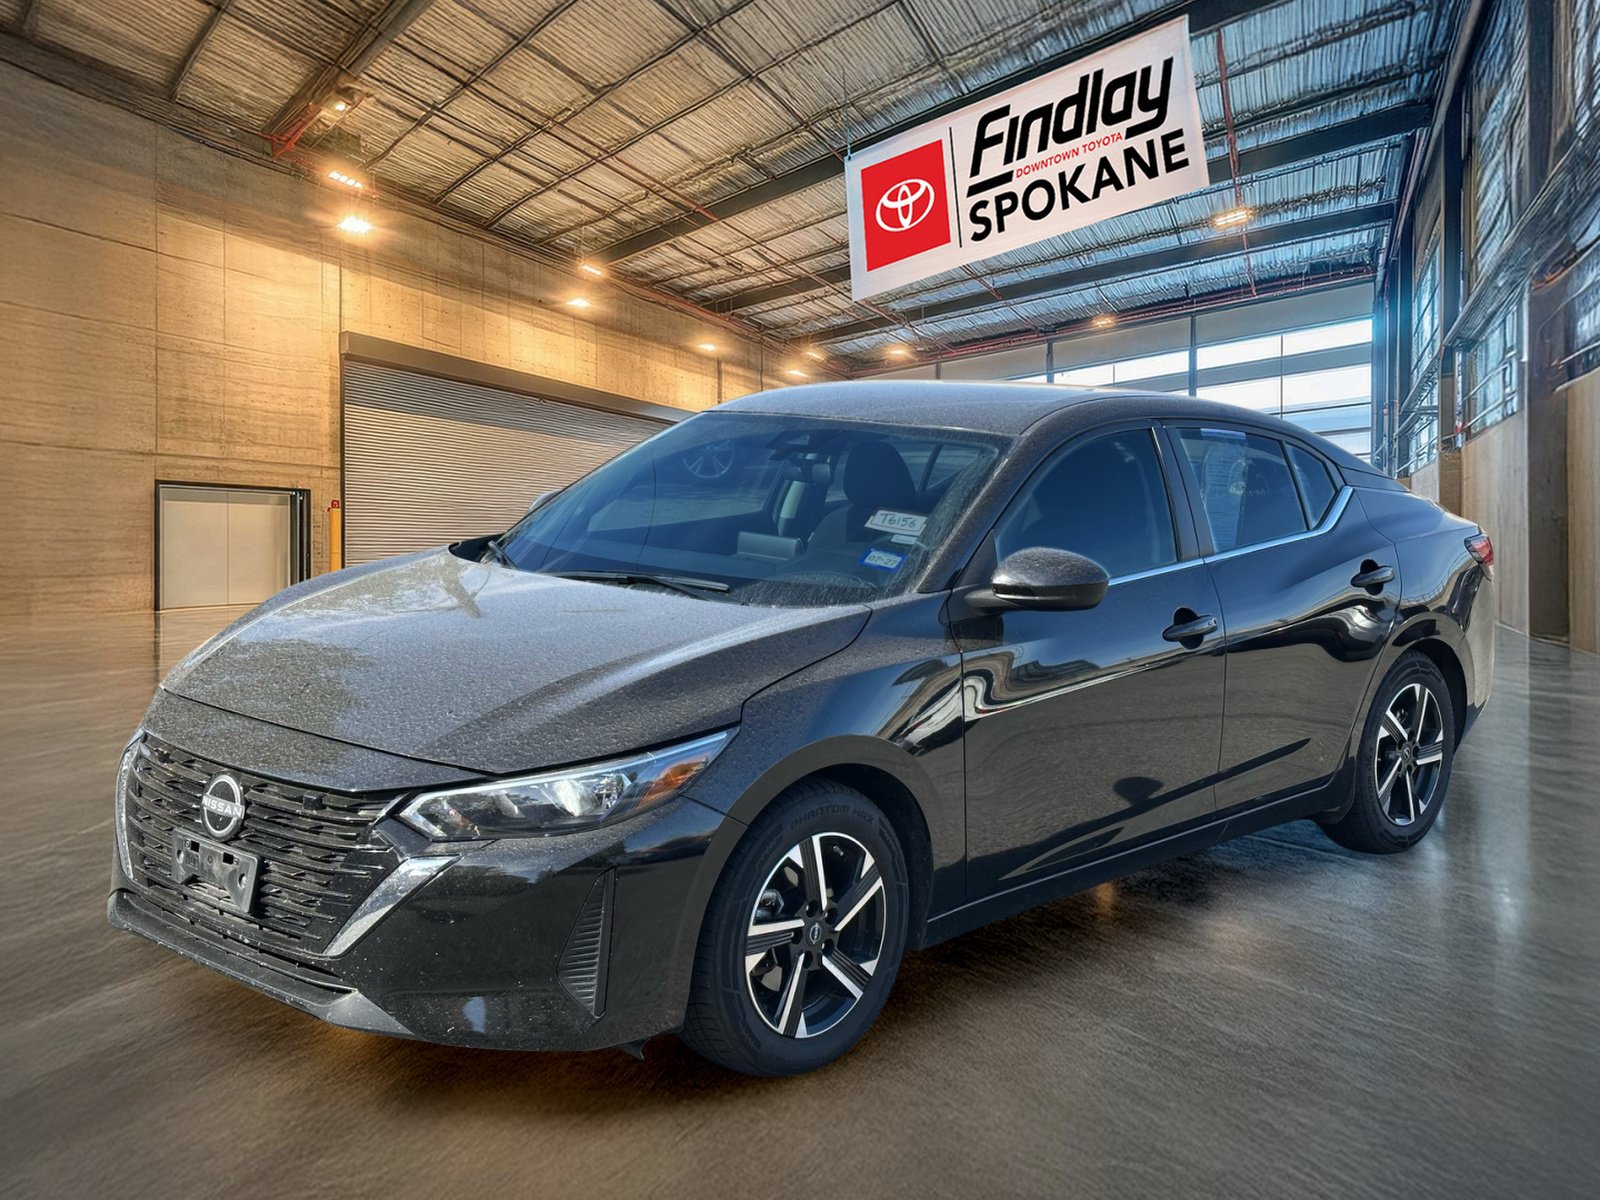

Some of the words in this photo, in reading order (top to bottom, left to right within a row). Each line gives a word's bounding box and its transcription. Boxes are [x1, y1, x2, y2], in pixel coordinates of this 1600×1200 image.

[969, 56, 1174, 180] Findlay
[1016, 148, 1080, 179] DOWNTOWN
[1082, 132, 1123, 155] TOYOTA
[968, 128, 1190, 243] SPOKANE
[880, 513, 918, 528] T6156
[202, 795, 243, 818] NISSAN
